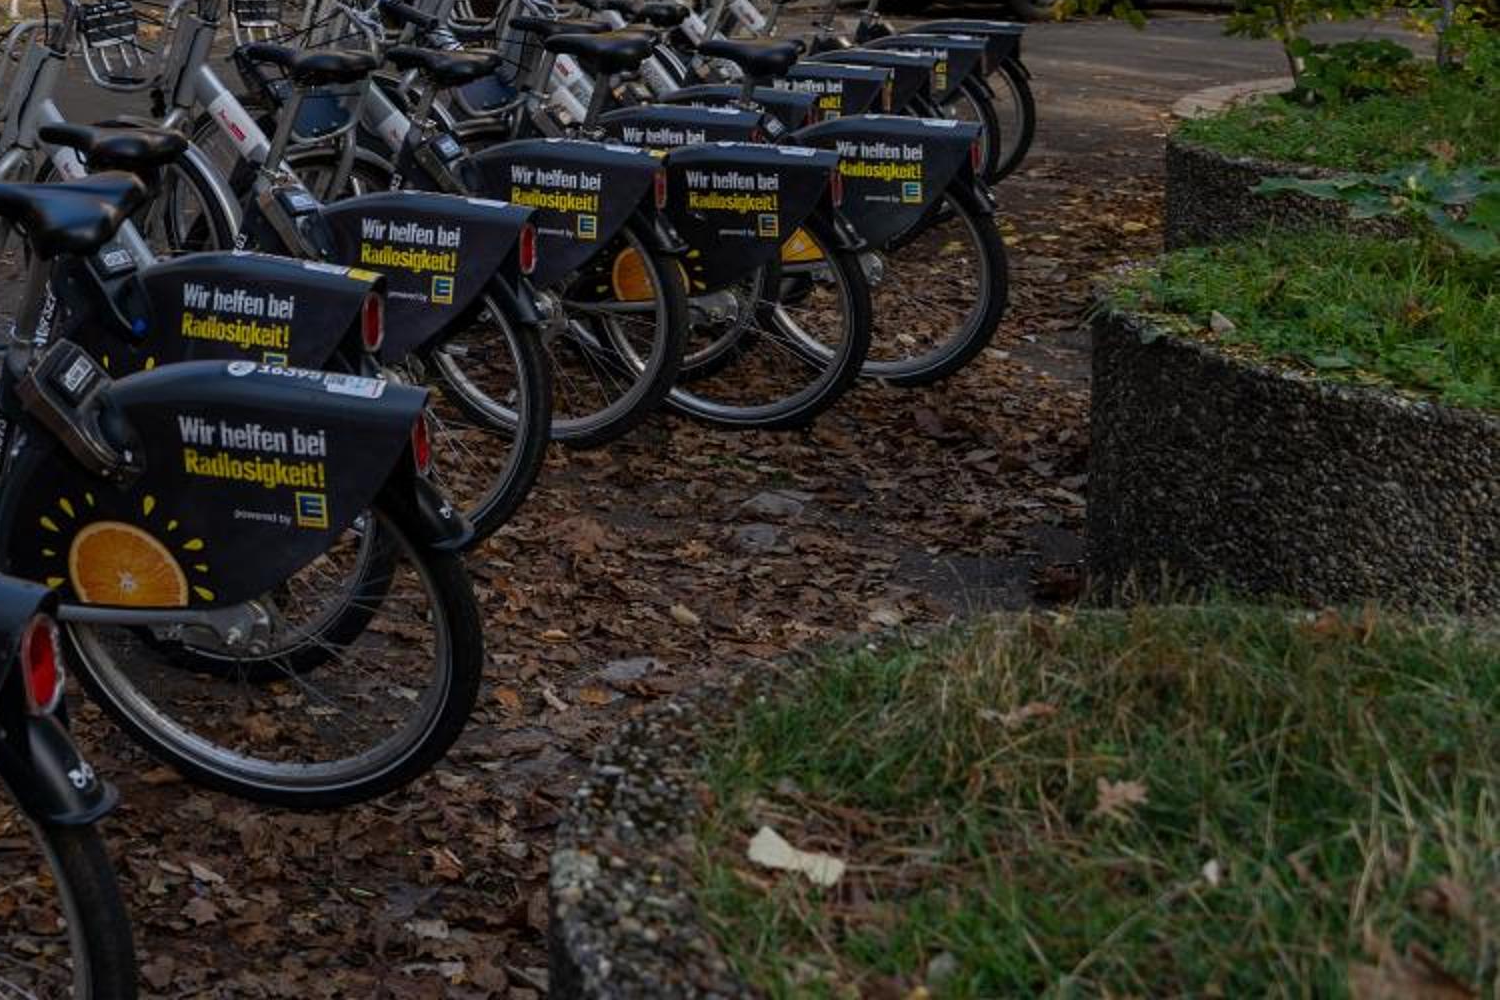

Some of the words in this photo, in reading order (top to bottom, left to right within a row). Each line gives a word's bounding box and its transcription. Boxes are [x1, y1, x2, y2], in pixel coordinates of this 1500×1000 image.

[623, 127, 643, 143] Wir
[646, 128, 684, 145] helfen
[836, 140, 859, 157] Wir
[861, 141, 900, 160] helfen
[903, 142, 923, 161] bei
[511, 164, 534, 185] Wir
[536, 167, 577, 189] helfen
[580, 171, 601, 192] bei
[686, 169, 709, 189] Wir
[712, 169, 754, 190] helfen
[757, 172, 778, 191] bei
[511, 186, 598, 213] Radlosigkeit!
[689, 191, 779, 215] Radlosigkeit!
[361, 216, 384, 241] Wir
[389, 220, 433, 246] helfen
[437, 226, 461, 249] bei
[361, 243, 456, 273] Radlosigkeit!
[183, 282, 206, 308] Wir
[213, 286, 264, 316] helfen
[267, 293, 295, 320] bei
[181, 312, 290, 349] Radlosigkeit!
[178, 414, 215, 445] Wir
[220, 420, 288, 454] helfen
[292, 427, 326, 457] bei
[184, 447, 325, 490] Radlosigkeit!
[233, 509, 277, 523] powered
[280, 512, 292, 526] by
